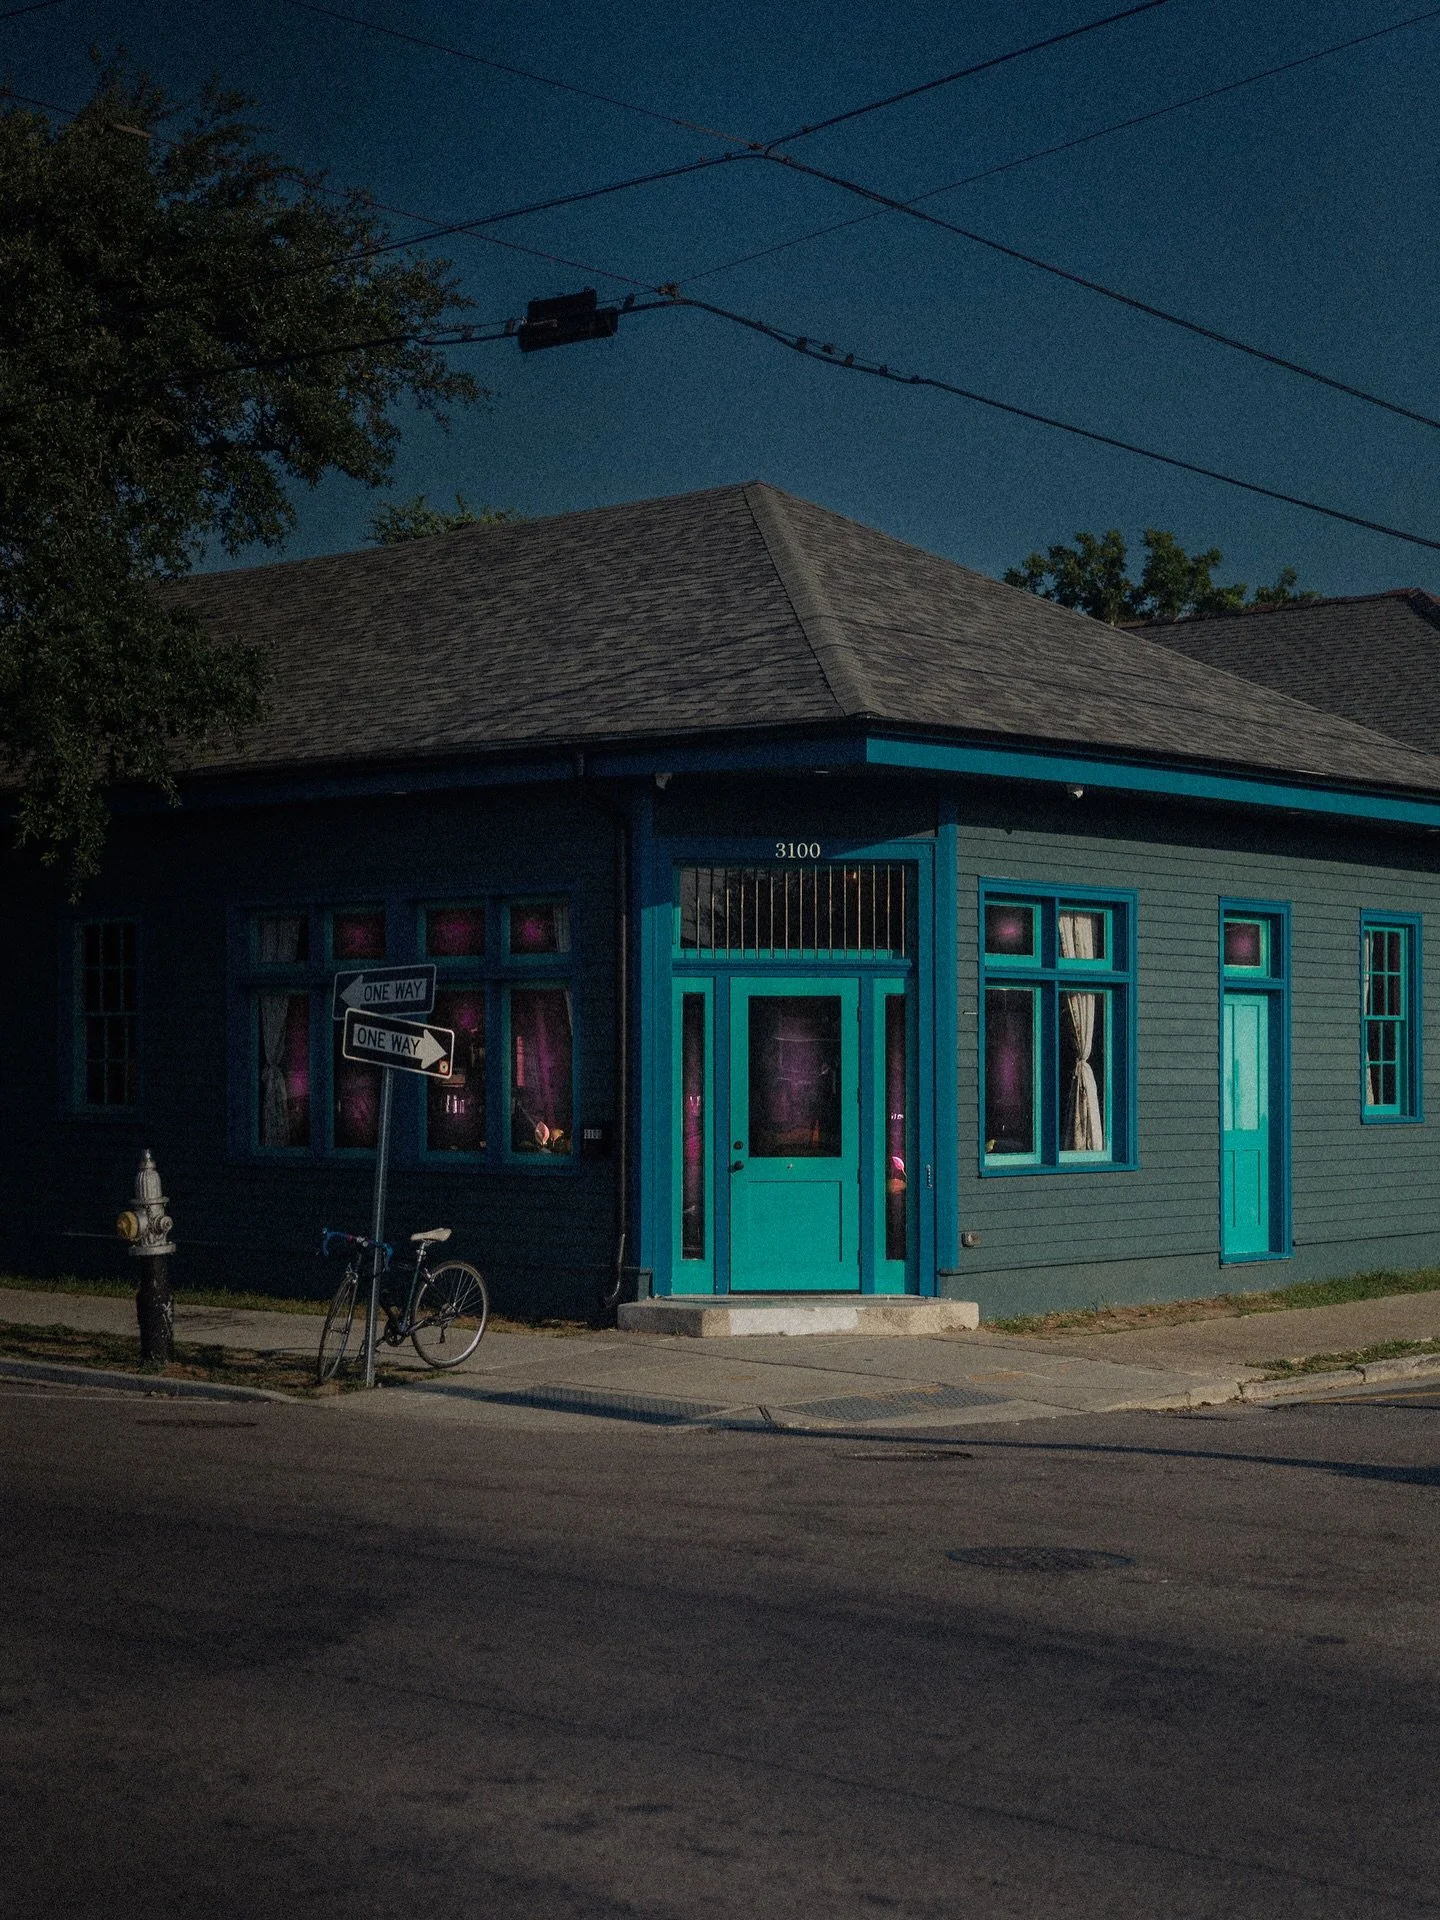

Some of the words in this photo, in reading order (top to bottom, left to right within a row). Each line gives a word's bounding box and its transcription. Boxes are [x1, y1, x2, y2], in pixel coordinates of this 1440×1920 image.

[775, 842, 821, 859] 3100
[363, 983, 390, 1002] ONE
[395, 981, 423, 999] WAY
[357, 1027, 386, 1049] ONE
[391, 1034, 420, 1055] WAY
